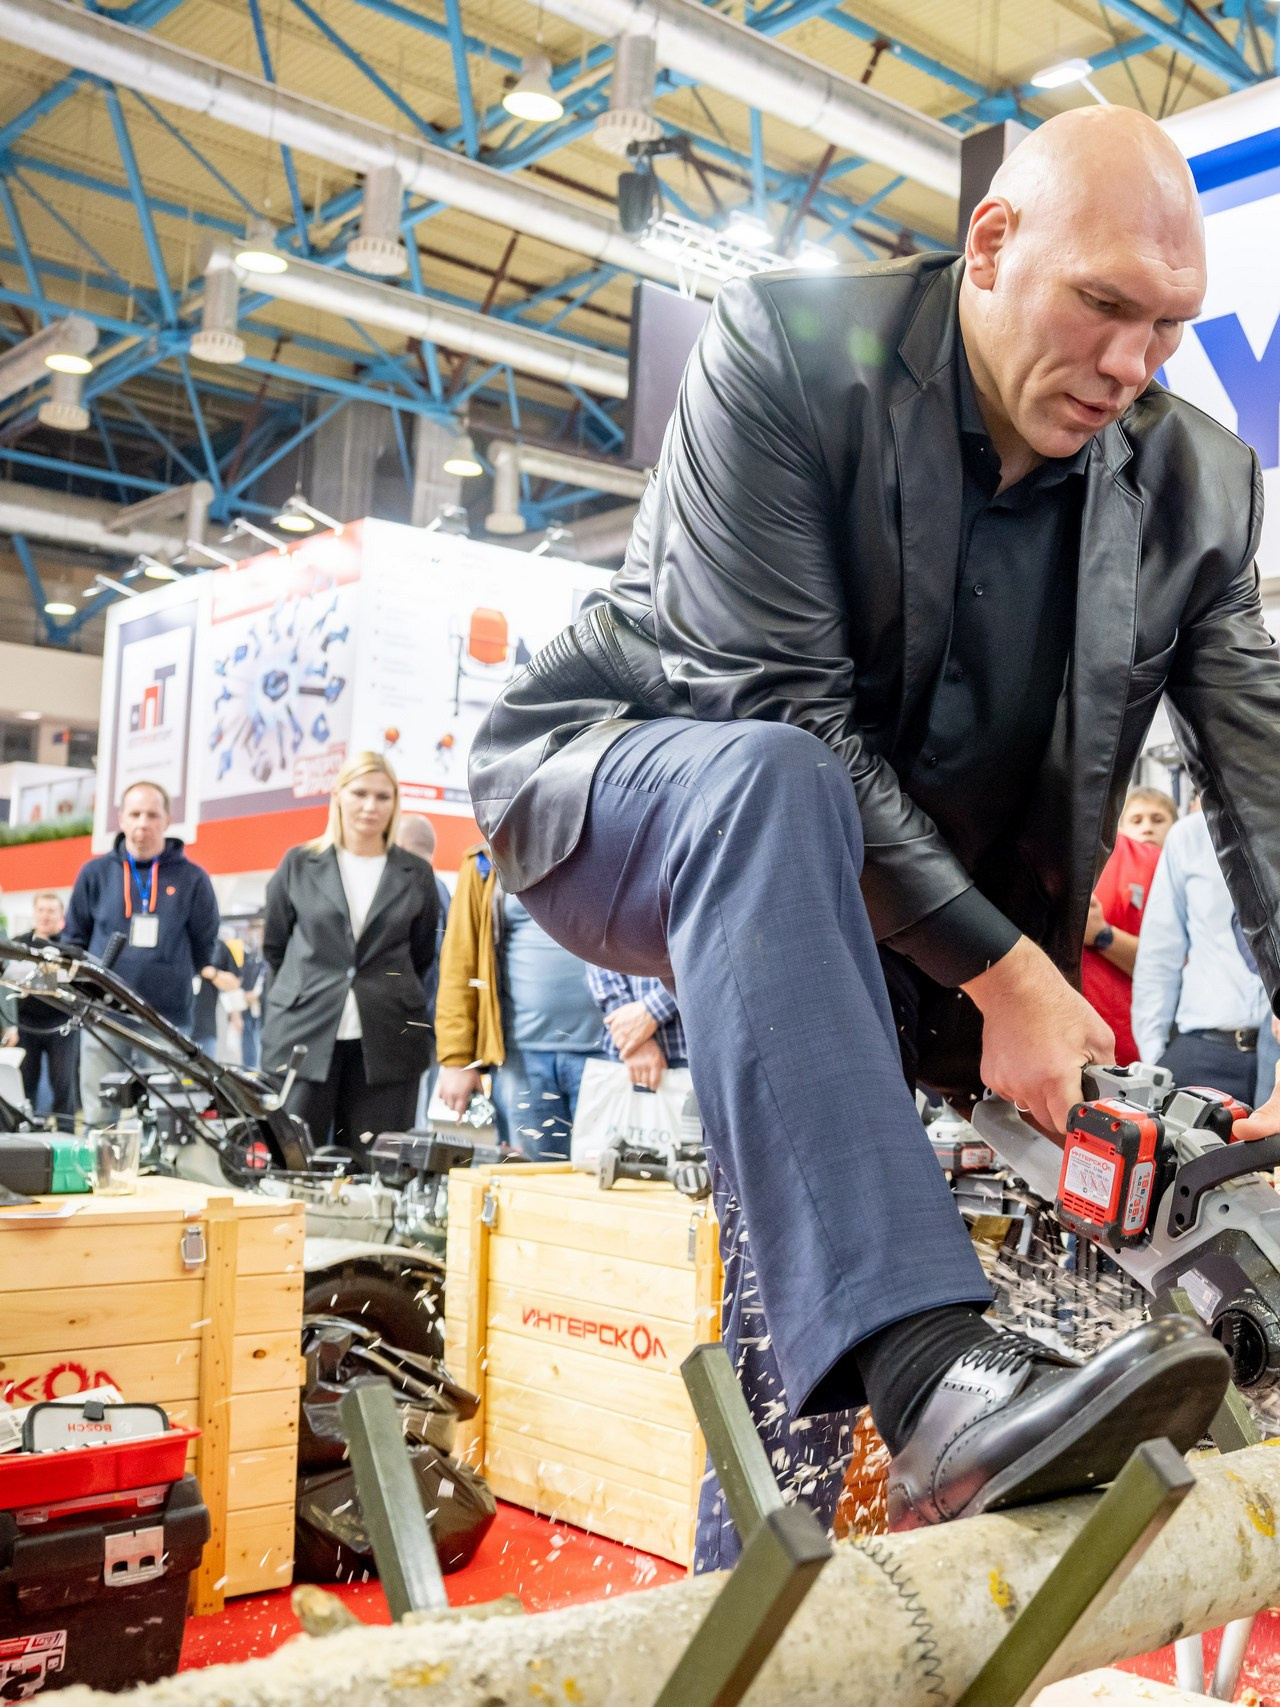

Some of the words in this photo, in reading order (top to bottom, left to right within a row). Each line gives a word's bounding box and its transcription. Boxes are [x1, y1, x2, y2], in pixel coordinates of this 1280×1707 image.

[521, 1304, 668, 1361] ИНТЕРСКОЛ
[0, 1361, 123, 1404] КОЛ
[67, 1423, 113, 1433] BOSCH
